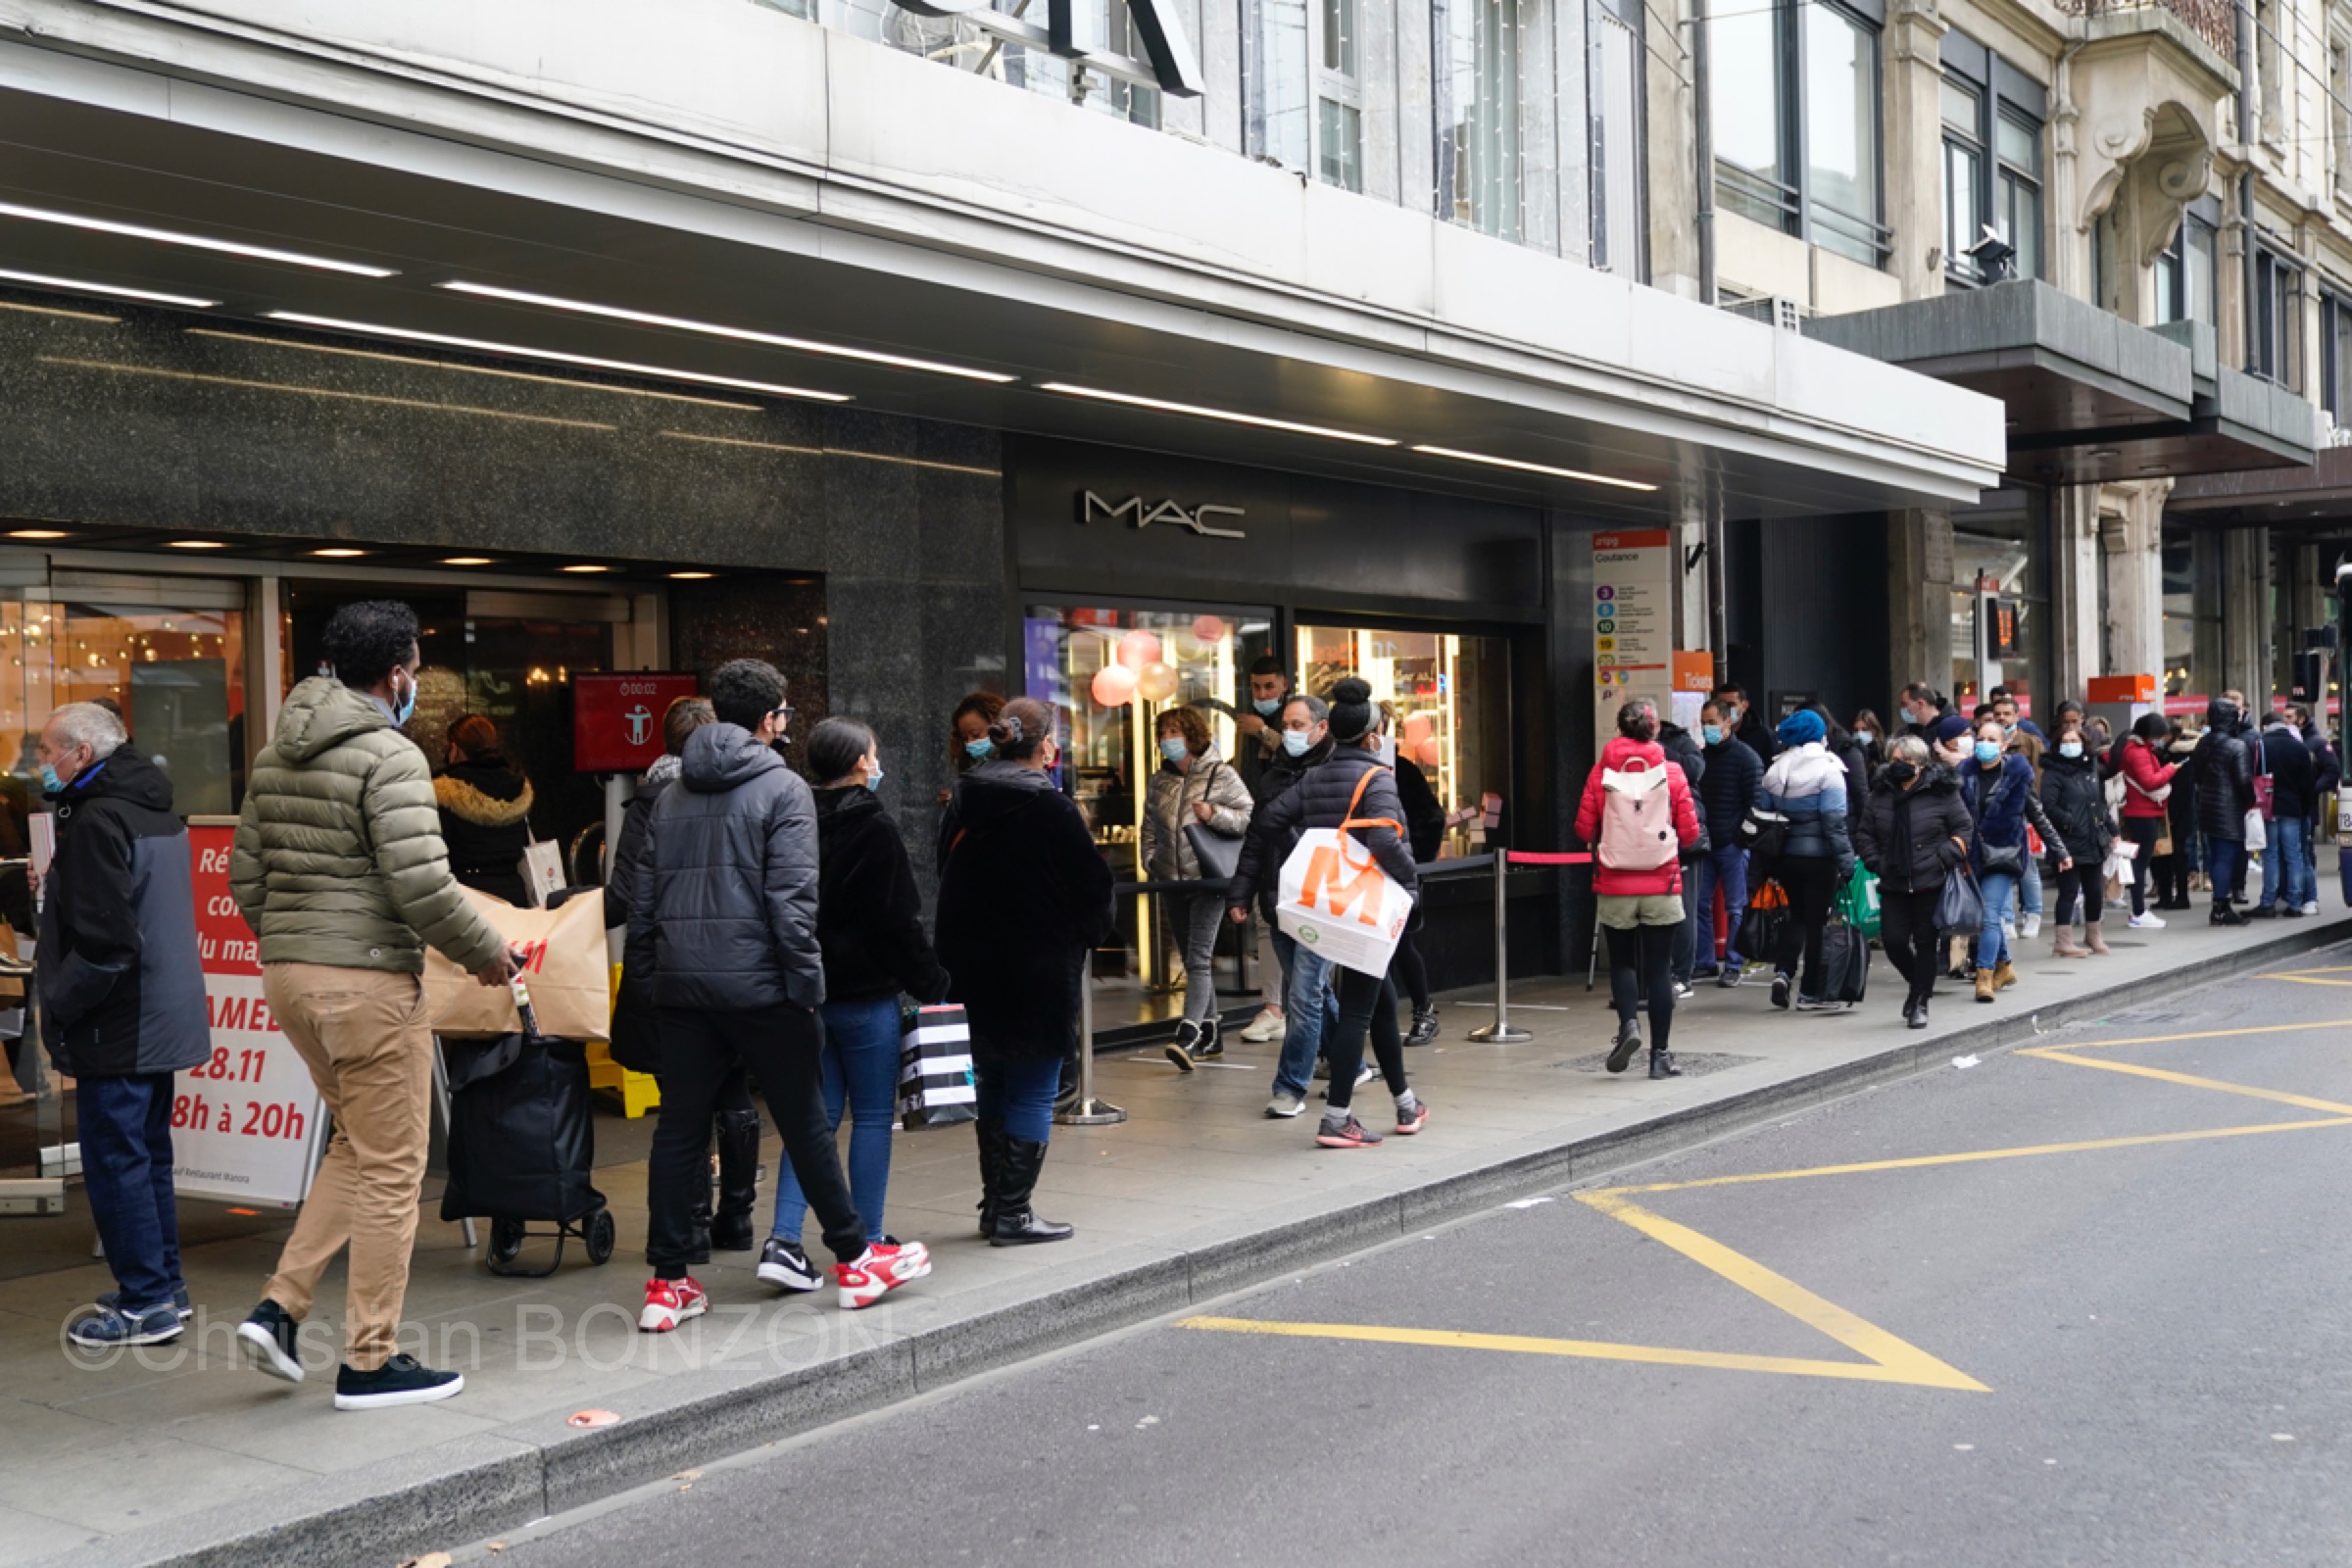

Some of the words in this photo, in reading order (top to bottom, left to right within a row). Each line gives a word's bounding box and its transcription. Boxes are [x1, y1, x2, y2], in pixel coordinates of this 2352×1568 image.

[1594, 553, 1639, 564] Coutance
[1298, 847, 1385, 926] M
[217, 1103, 232, 1134] à
[241, 1101, 305, 1141] 20h
[185, 1167, 222, 1181] Restaurant
